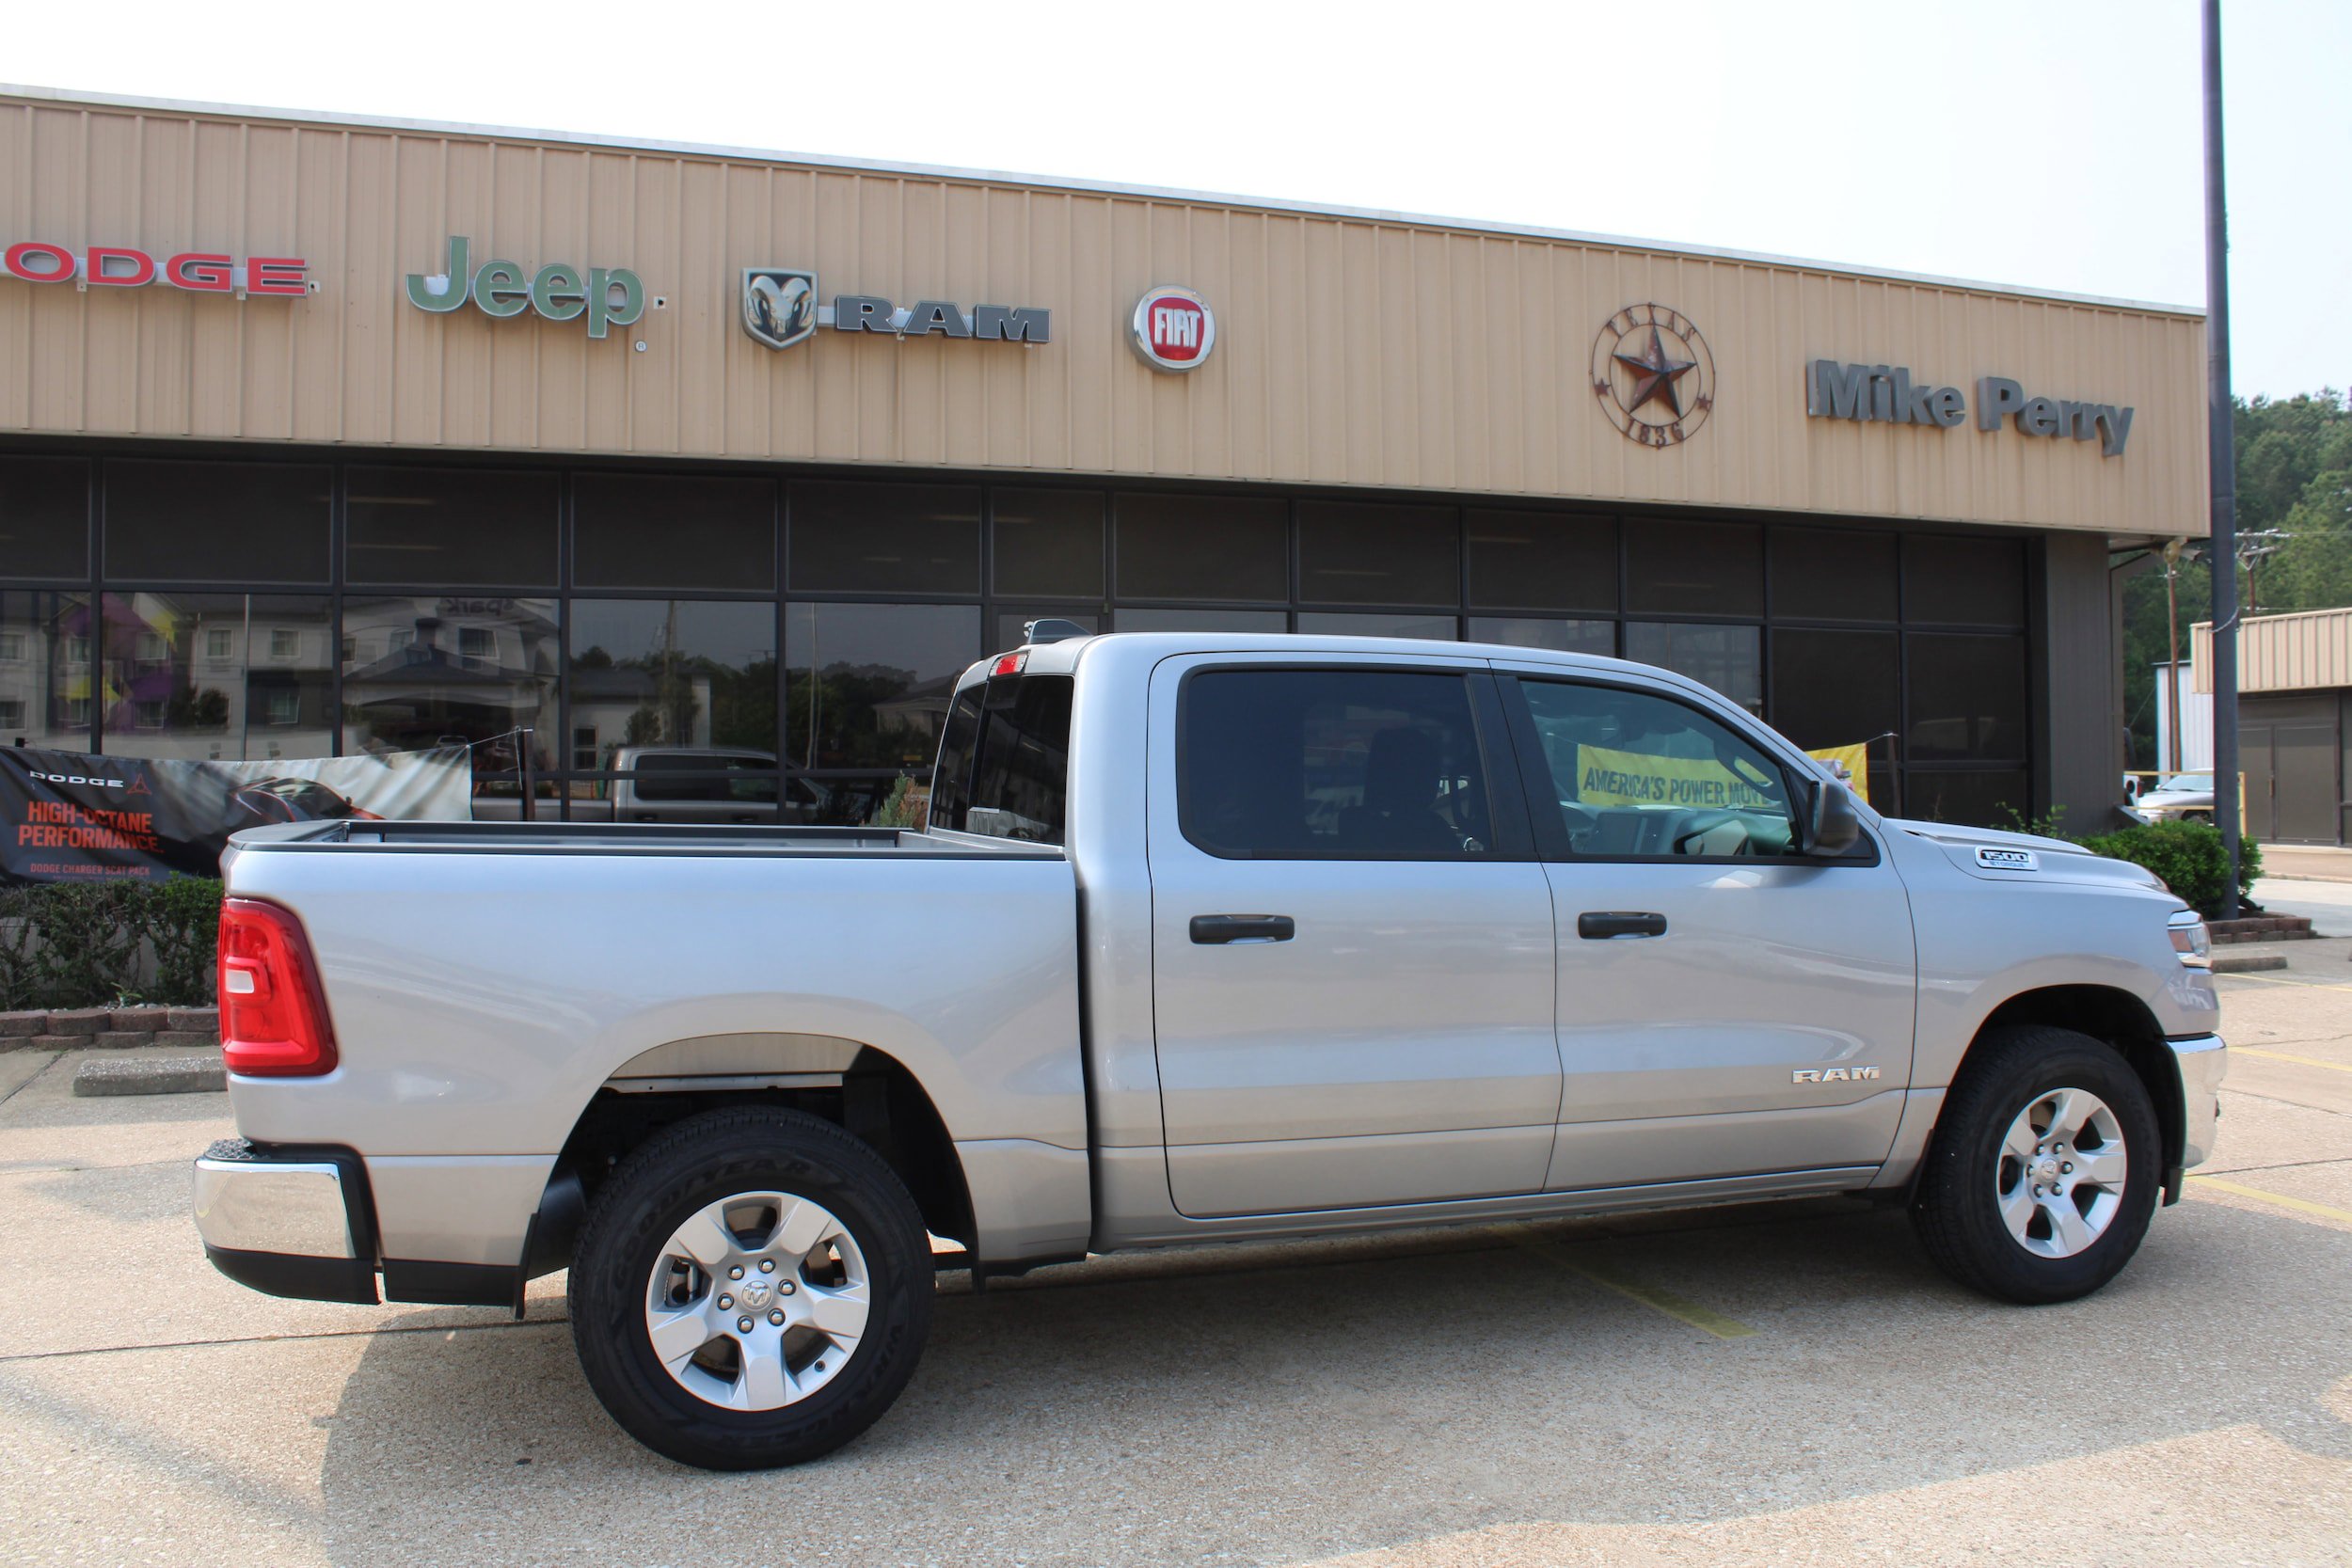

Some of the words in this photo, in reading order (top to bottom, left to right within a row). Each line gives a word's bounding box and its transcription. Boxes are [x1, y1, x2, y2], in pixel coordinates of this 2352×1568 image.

[4, 242, 309, 296] ODGE
[405, 235, 646, 339] Jeep
[835, 294, 1052, 343] RAM
[1153, 306, 1201, 348] FIAT
[1605, 302, 1698, 342] TEXAS
[1806, 359, 1966, 429] Mike
[1977, 376, 2135, 457] Perry
[1623, 419, 1684, 448] 1836
[29, 769, 124, 788] DODGE
[1582, 766, 1666, 800] AMERICA'S
[1668, 778, 1725, 803] POWER
[1727, 782, 1773, 805] MOV
[27, 800, 152, 833] HIGH-OCTANE
[30, 863, 61, 874] DODGE
[62, 864, 103, 875] CHARGER
[104, 865, 126, 876] SCAT
[128, 866, 151, 877] PACK
[1984, 850, 2029, 863] 1500
[1791, 1066, 1881, 1084] RAM
